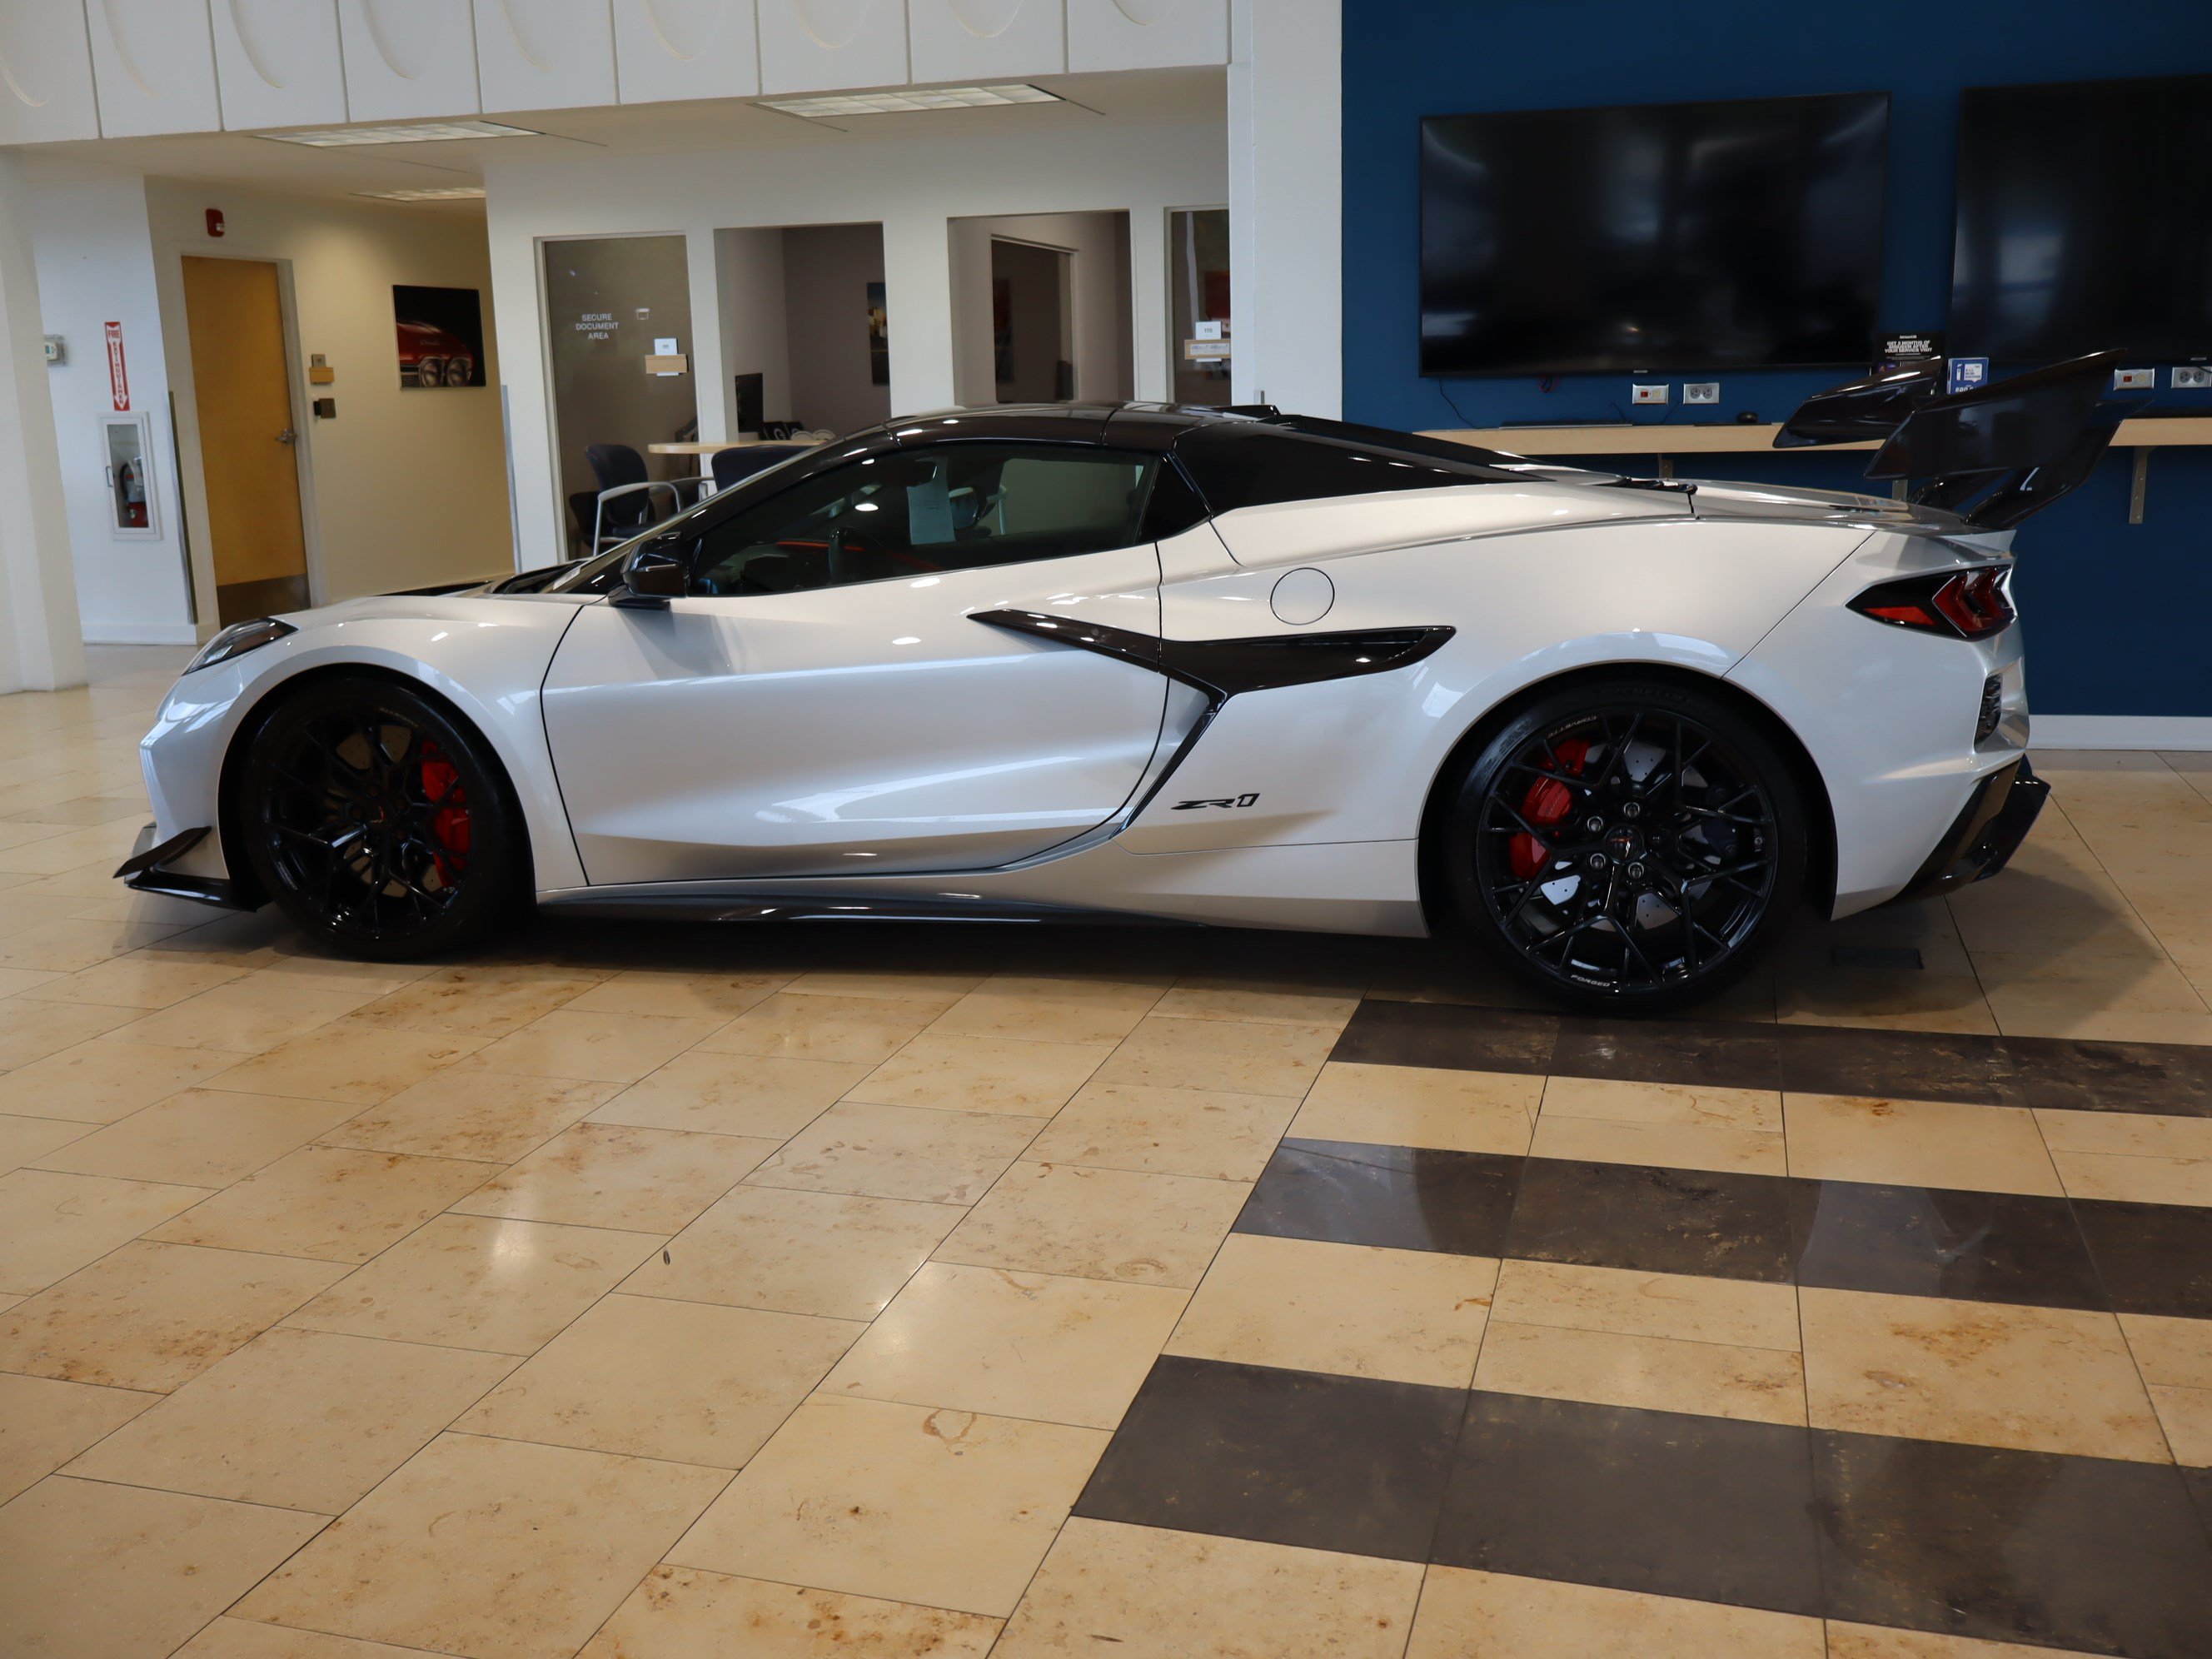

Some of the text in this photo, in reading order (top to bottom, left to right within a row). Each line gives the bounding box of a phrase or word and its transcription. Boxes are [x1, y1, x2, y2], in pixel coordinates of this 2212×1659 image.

[582, 313, 612, 321] SECURE
[575, 322, 619, 331] DOCUMENT
[107, 330, 120, 338] FIRE
[112, 341, 124, 404] EXTINGUISHER
[1571, 974, 1610, 987] FORGED
